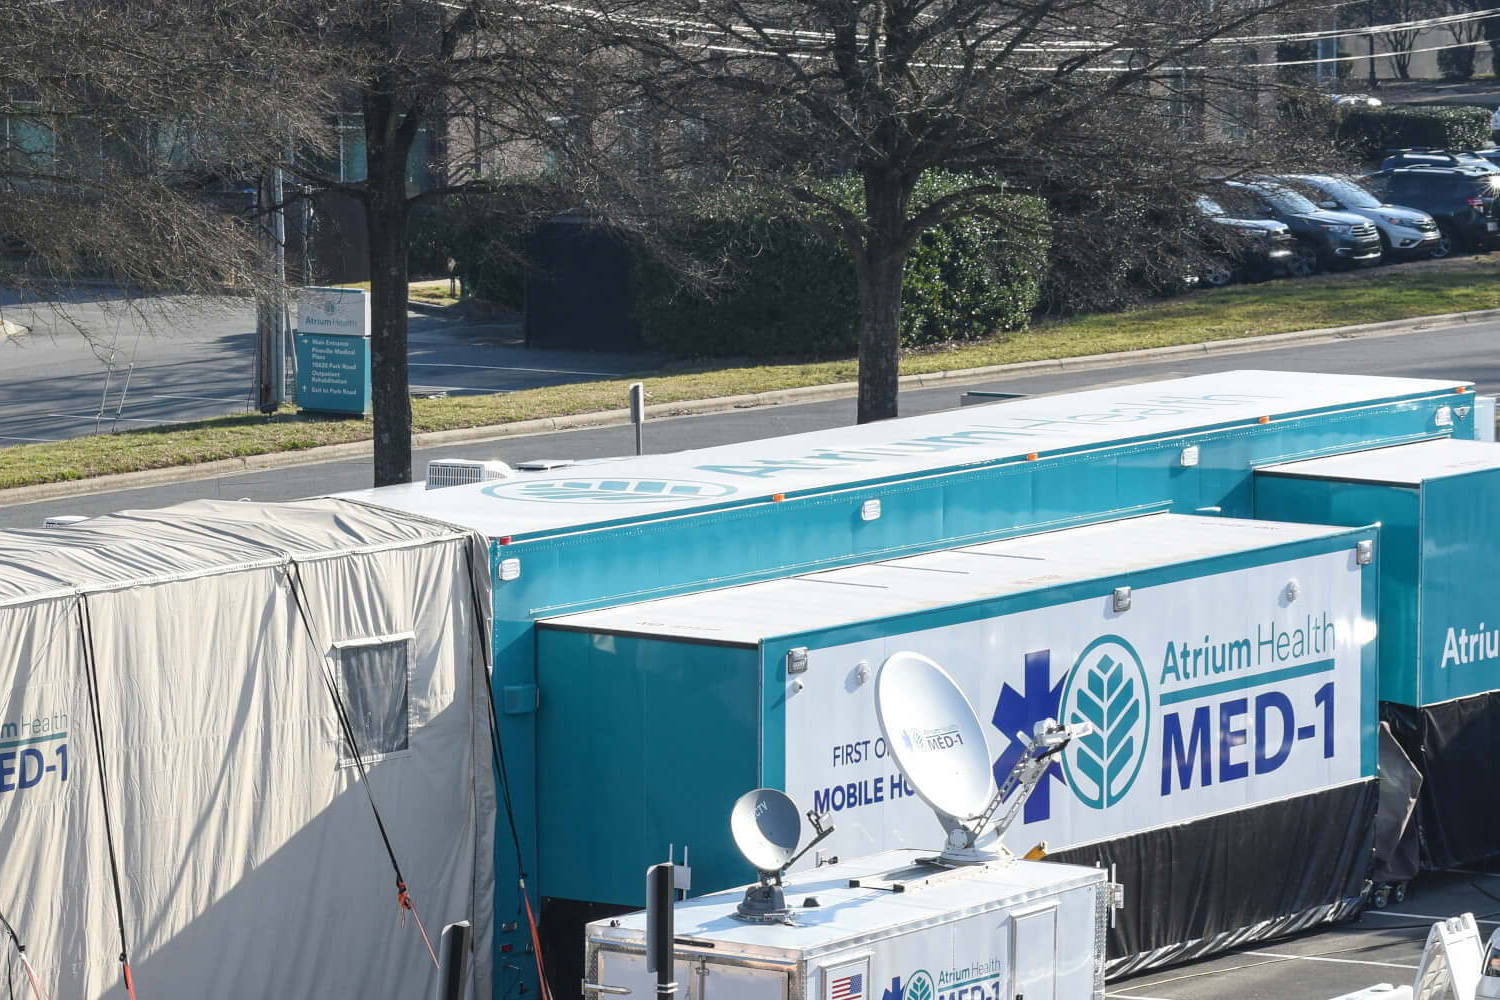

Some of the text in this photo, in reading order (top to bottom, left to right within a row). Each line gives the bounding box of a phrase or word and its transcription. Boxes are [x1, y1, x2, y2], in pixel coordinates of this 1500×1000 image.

[305, 316, 357, 328] Atrium Health
[1160, 611, 1336, 685] Atrium Health
[1441, 622, 1500, 668] Atriu
[21, 710, 68, 736] Health
[833, 737, 890, 768] FIRST O
[927, 733, 964, 751] MED-1
[1160, 681, 1335, 797] MED-1
[814, 777, 884, 814] MOBILE
[938, 956, 1001, 986] Atrium Health
